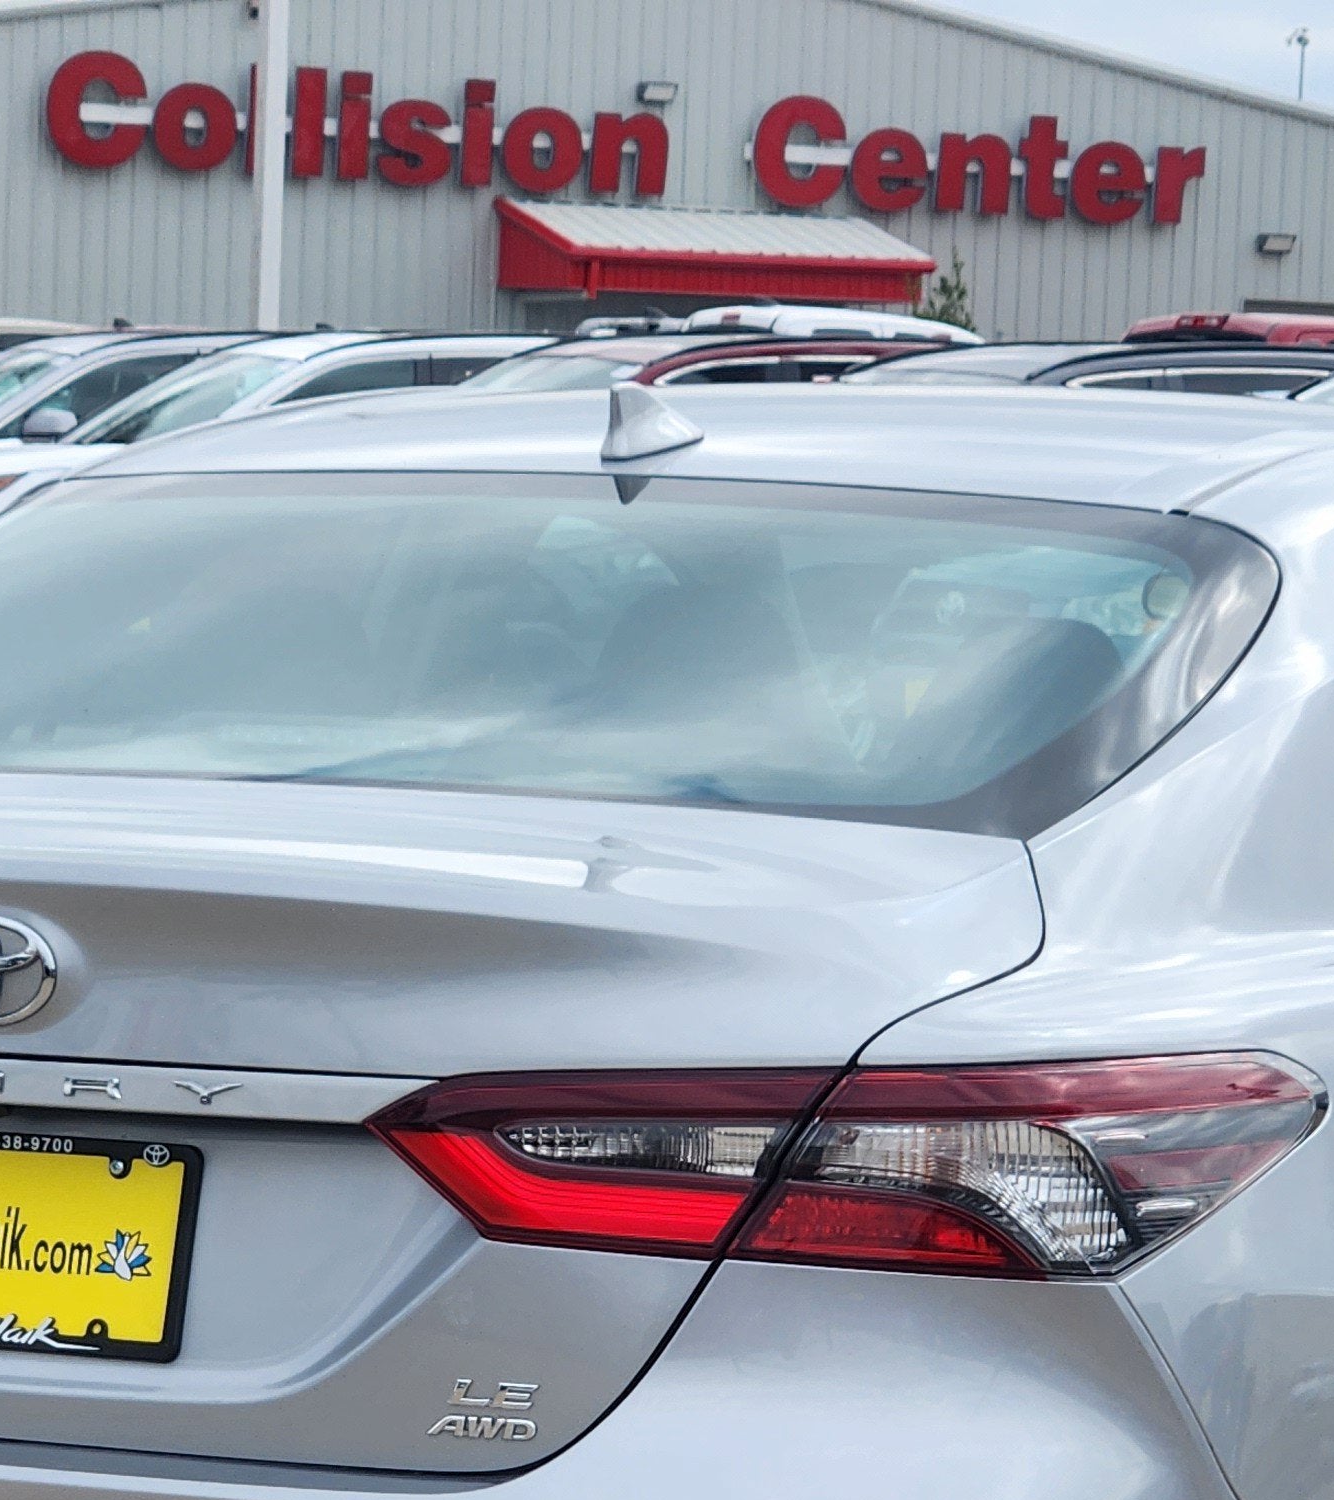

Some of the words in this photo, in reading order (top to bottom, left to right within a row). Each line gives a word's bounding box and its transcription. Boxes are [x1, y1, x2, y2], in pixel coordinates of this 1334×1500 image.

[46, 50, 669, 197] Colision
[752, 94, 1207, 226] Center
[446, 1378, 540, 1411] LE
[426, 1413, 538, 1441] AWD
